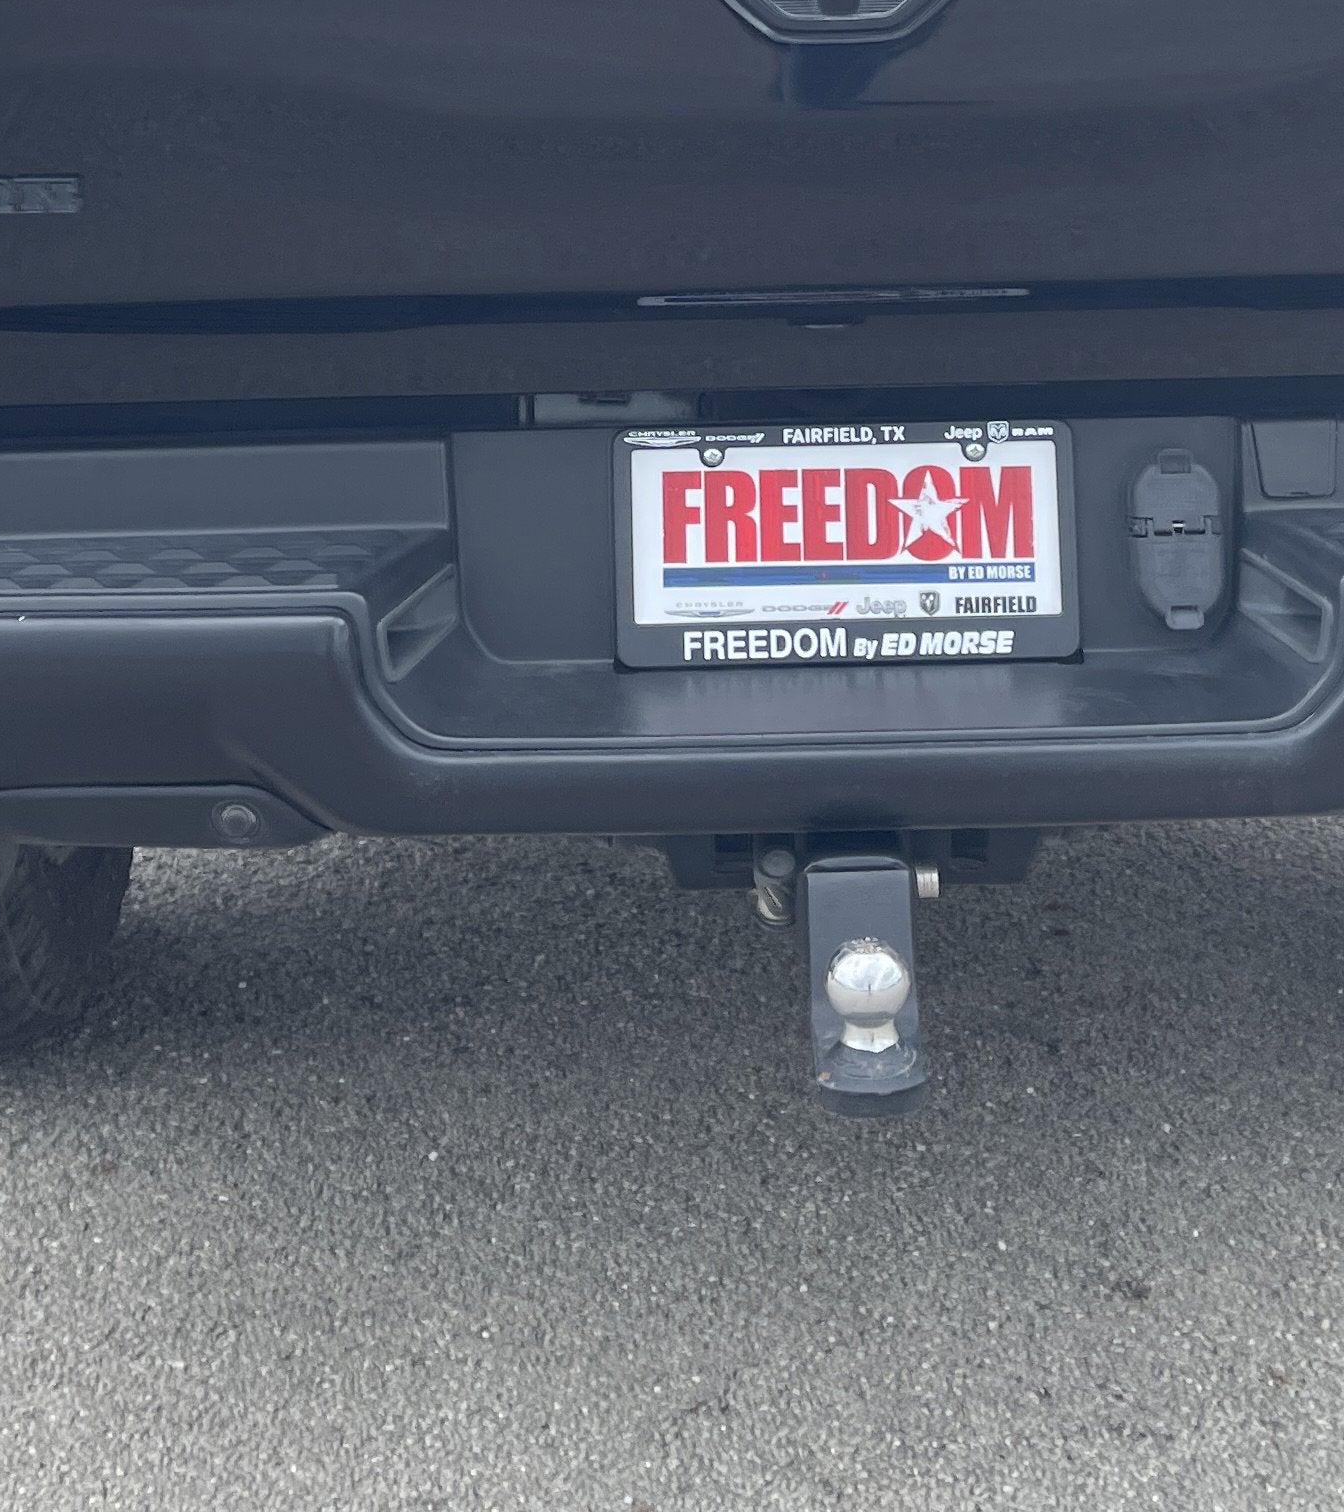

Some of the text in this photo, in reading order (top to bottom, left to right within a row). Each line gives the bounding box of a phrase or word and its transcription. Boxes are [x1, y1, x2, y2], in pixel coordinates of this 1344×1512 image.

[628, 430, 696, 438] CHRYSLER
[782, 426, 906, 445] FAIRFIELD, TX
[944, 425, 983, 441] Jeep
[1011, 427, 1054, 437] RAM
[662, 465, 1035, 564] FREEDOM
[948, 564, 1032, 580] BY ED MORSE
[856, 596, 907, 617] Jeep
[955, 595, 1037, 614] FAIRFIELD
[683, 627, 1015, 660] FREEDOM By ED MORSE
